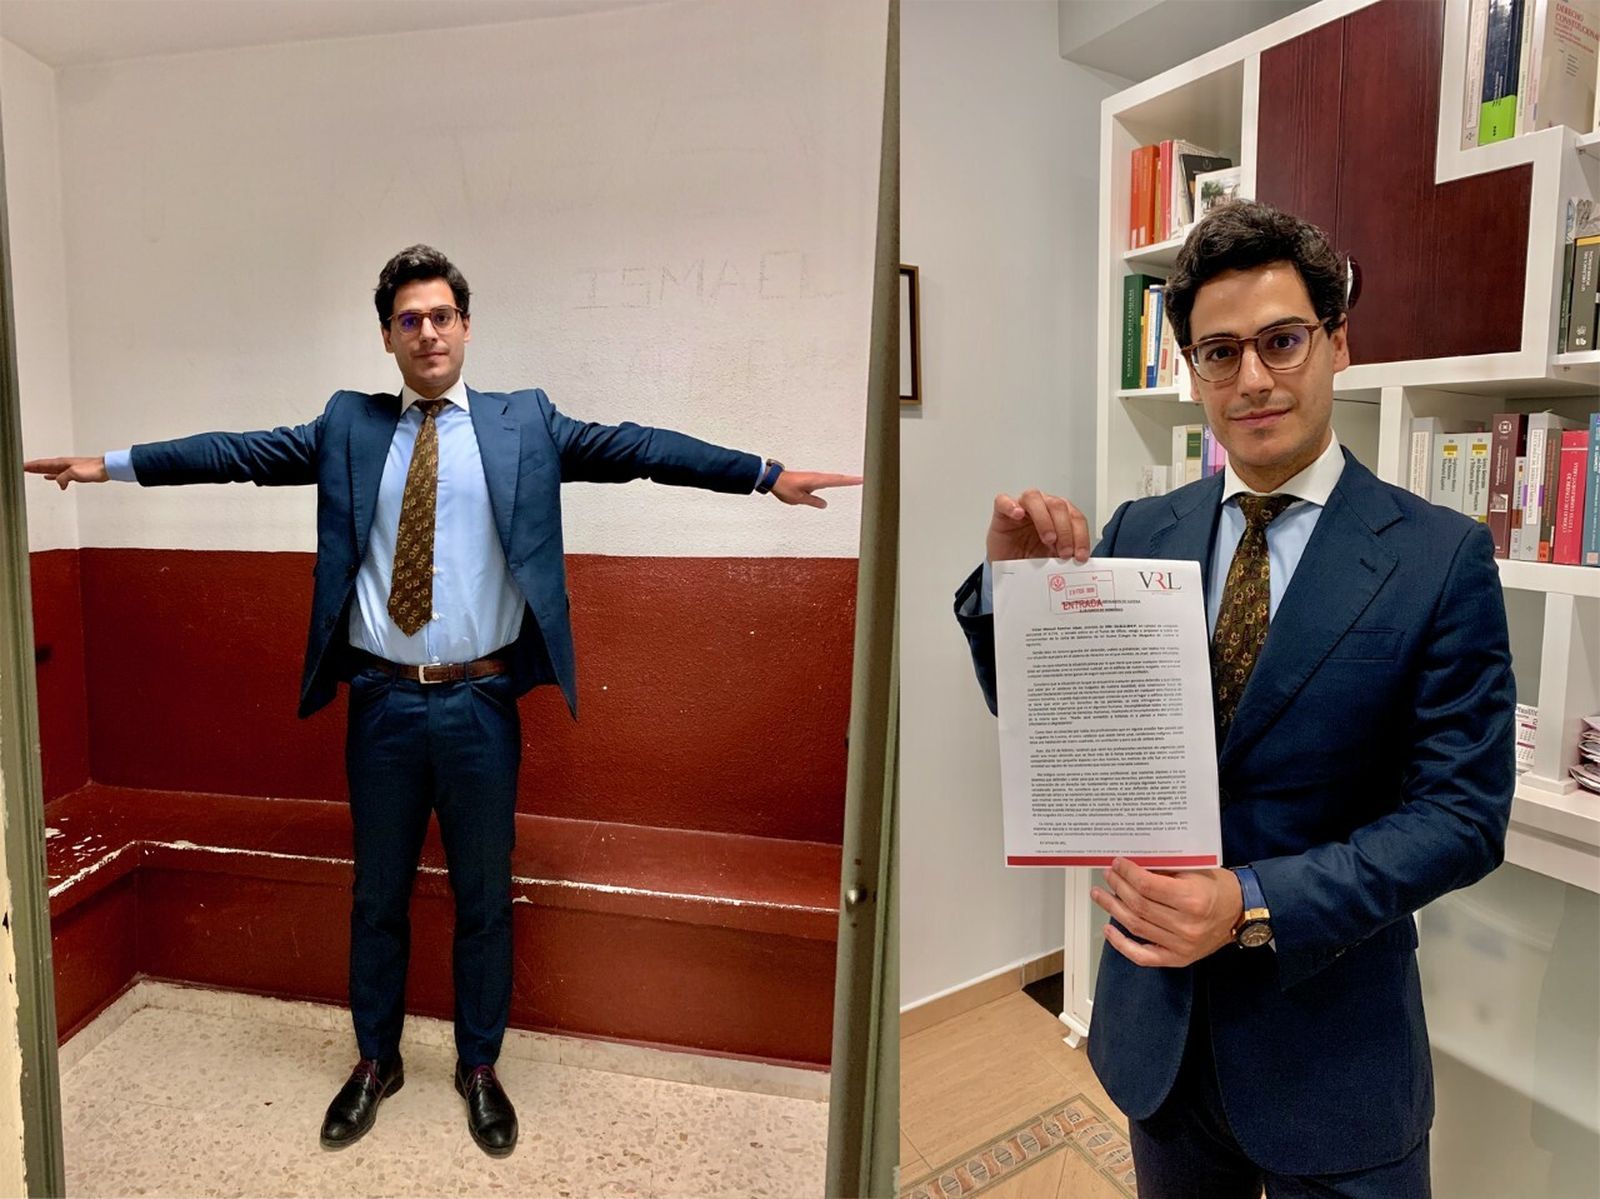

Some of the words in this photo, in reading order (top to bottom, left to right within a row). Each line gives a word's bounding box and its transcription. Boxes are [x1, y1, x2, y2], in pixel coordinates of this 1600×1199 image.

[1555, 13, 1600, 41] CONSTITUCIONA
[573, 250, 845, 309] ISMAEL
[1138, 570, 1182, 590] VRL
[1061, 598, 1103, 611] ENTRADA
